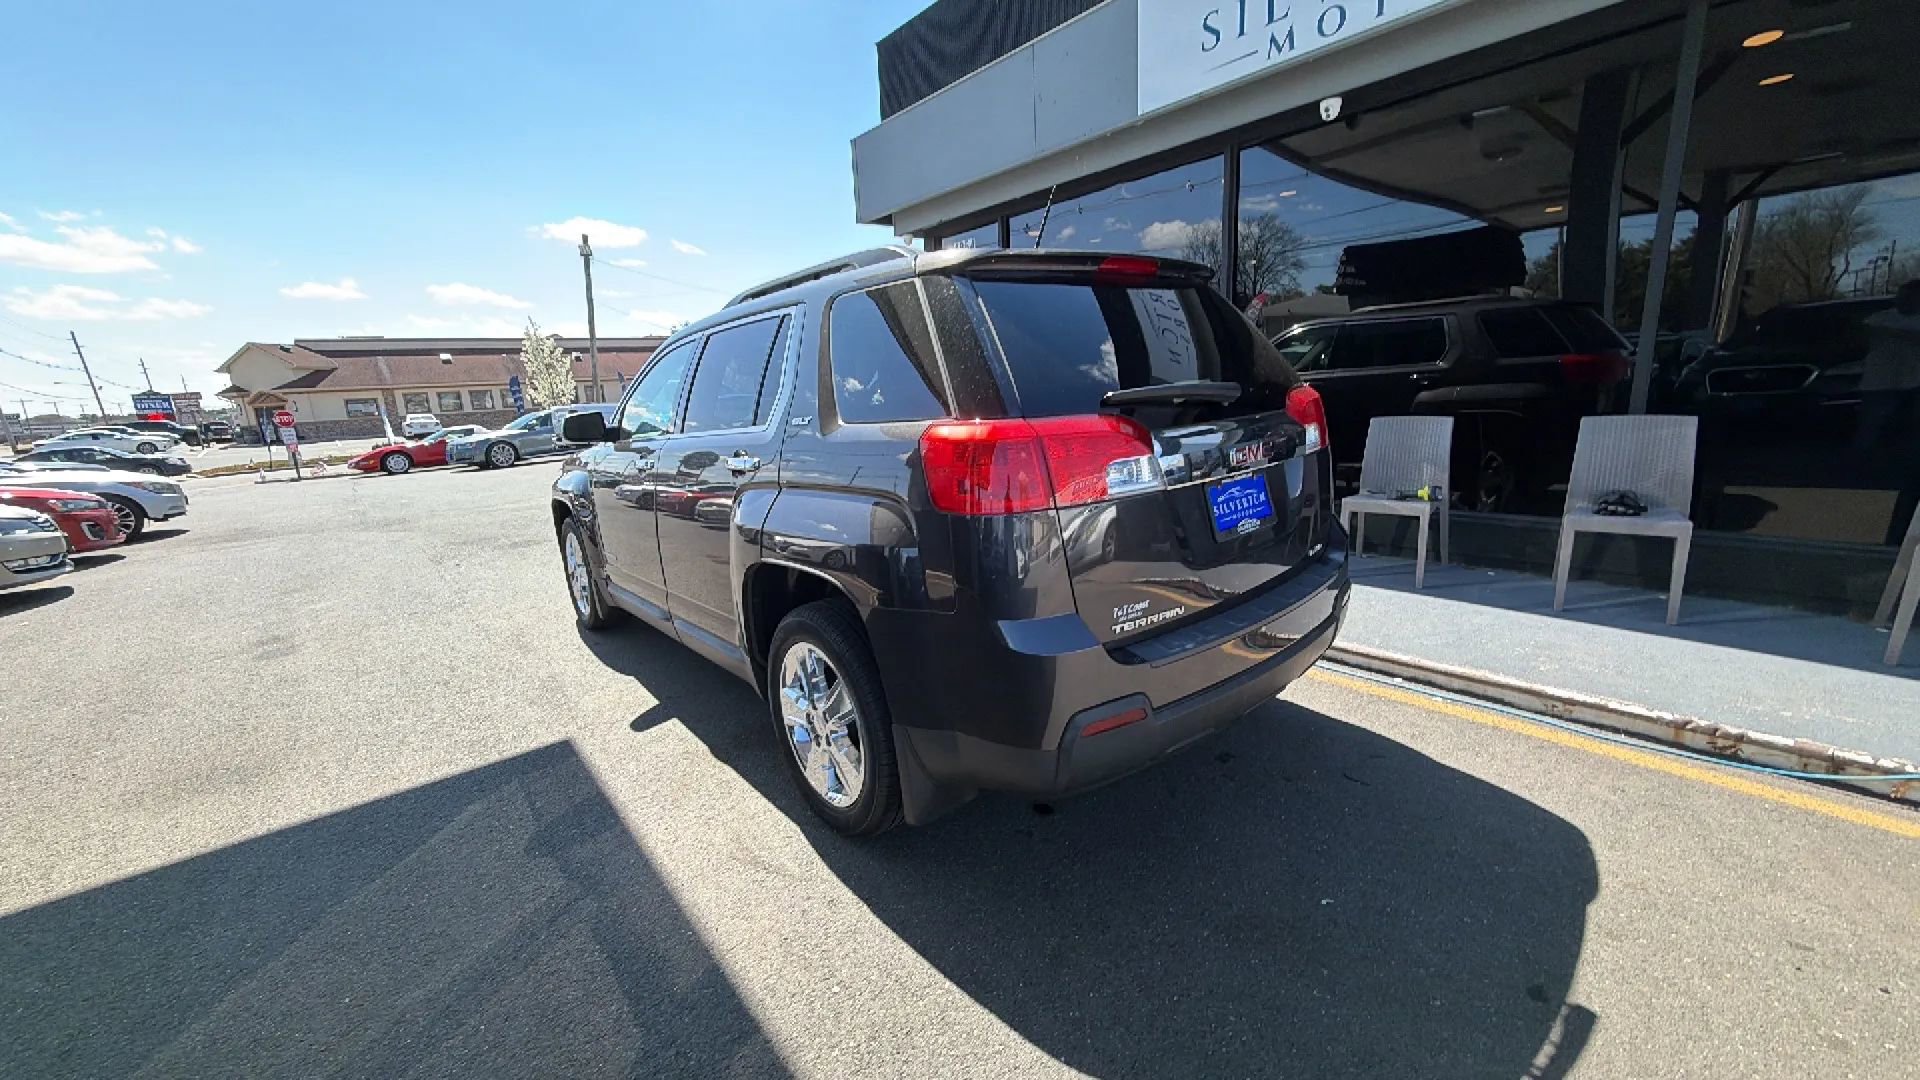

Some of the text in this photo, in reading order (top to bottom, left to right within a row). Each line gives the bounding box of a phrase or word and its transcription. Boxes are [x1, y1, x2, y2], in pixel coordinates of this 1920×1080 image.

[1201, 0, 1324, 52] SIL
[1230, 441, 1274, 467] GMC
[1112, 605, 1185, 634] TERRAIN
